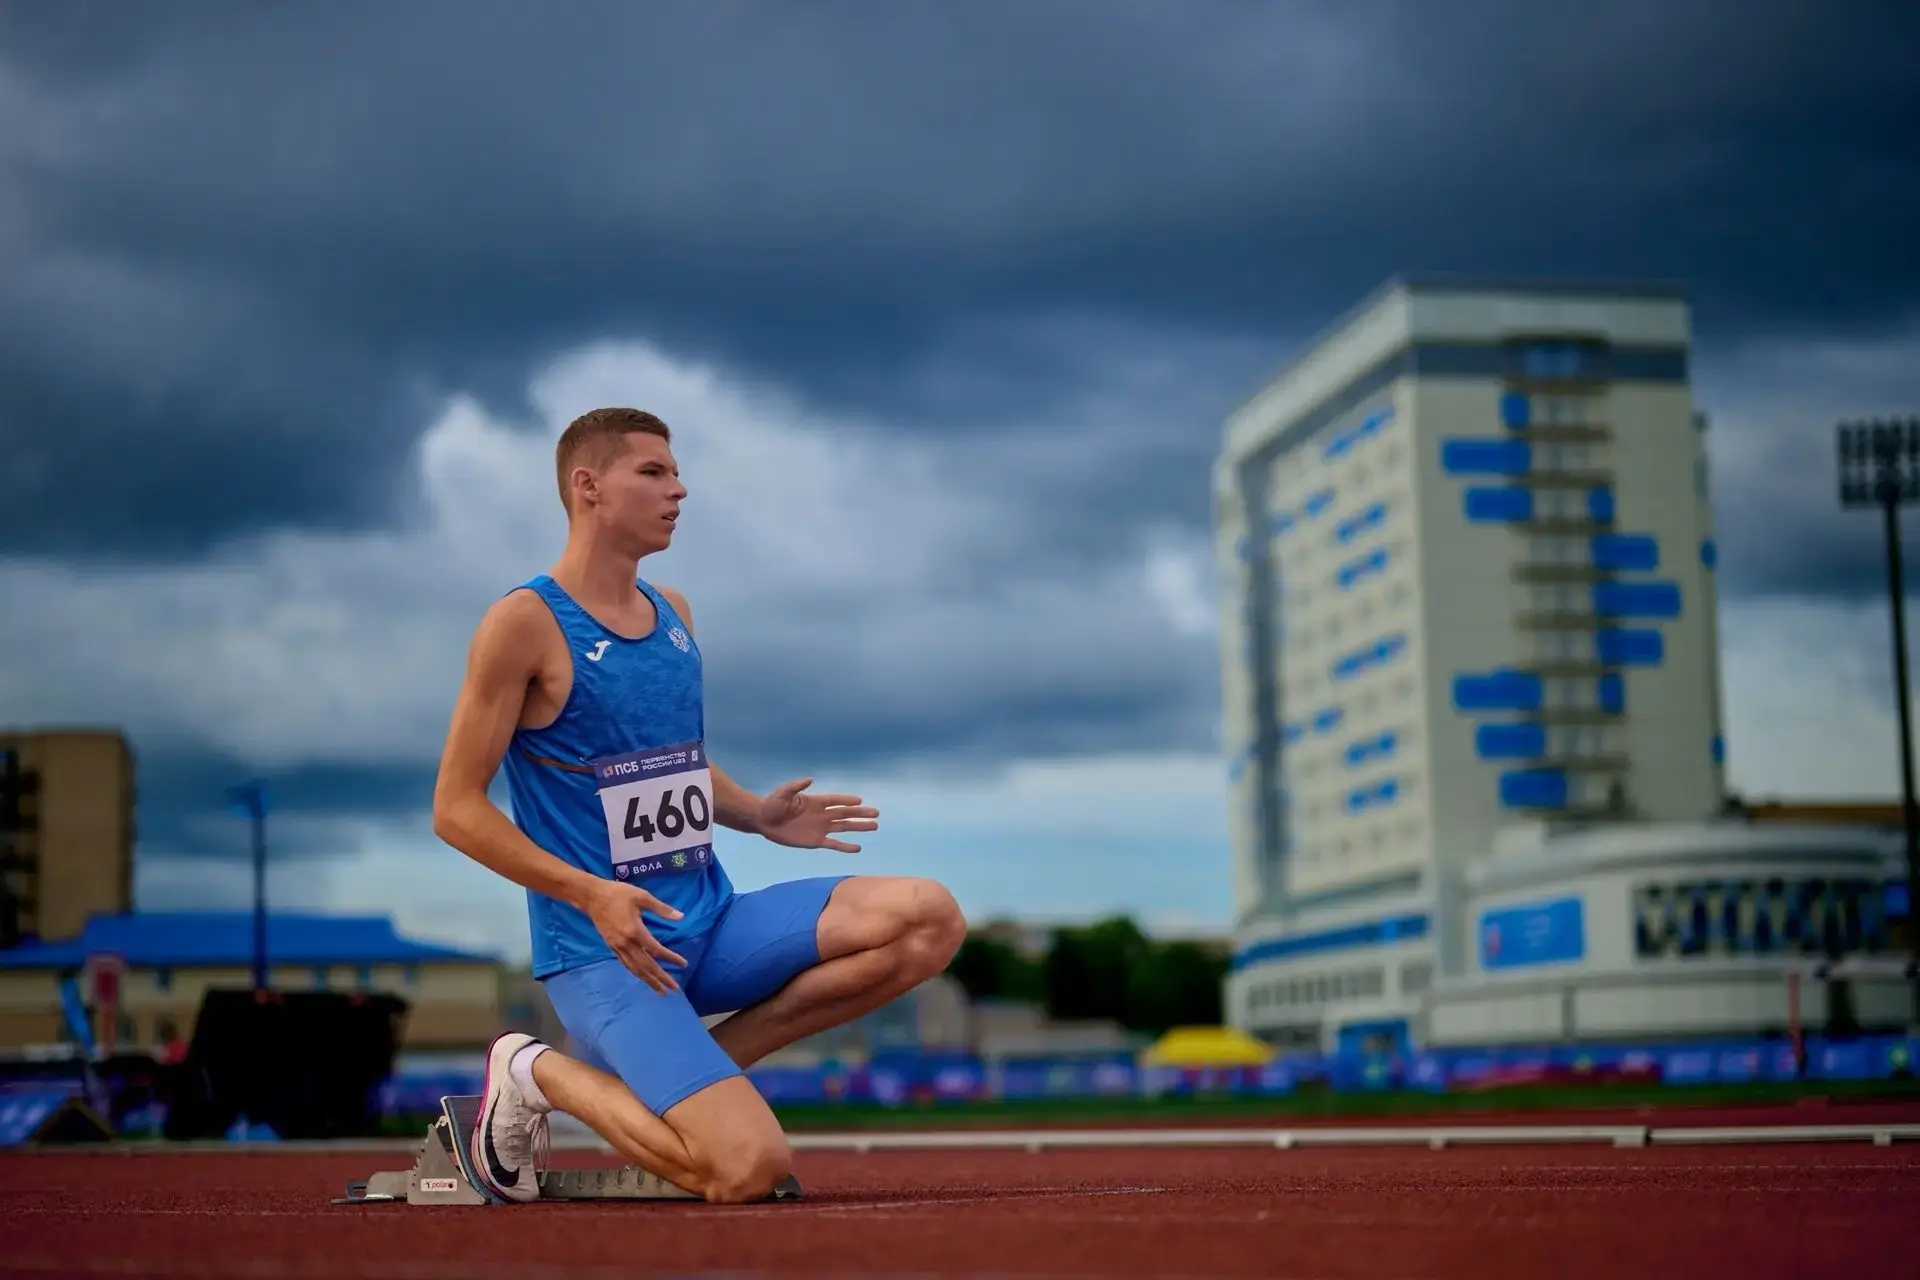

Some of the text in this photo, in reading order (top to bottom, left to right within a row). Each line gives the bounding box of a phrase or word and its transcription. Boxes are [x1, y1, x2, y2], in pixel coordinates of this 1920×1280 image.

[641, 751, 686, 765] ПЕРВЕНСТВО
[642, 760, 672, 770] РОССИИ
[615, 761, 639, 775] ПСБ
[624, 785, 709, 843] 460
[633, 861, 662, 874] ВФЛА
